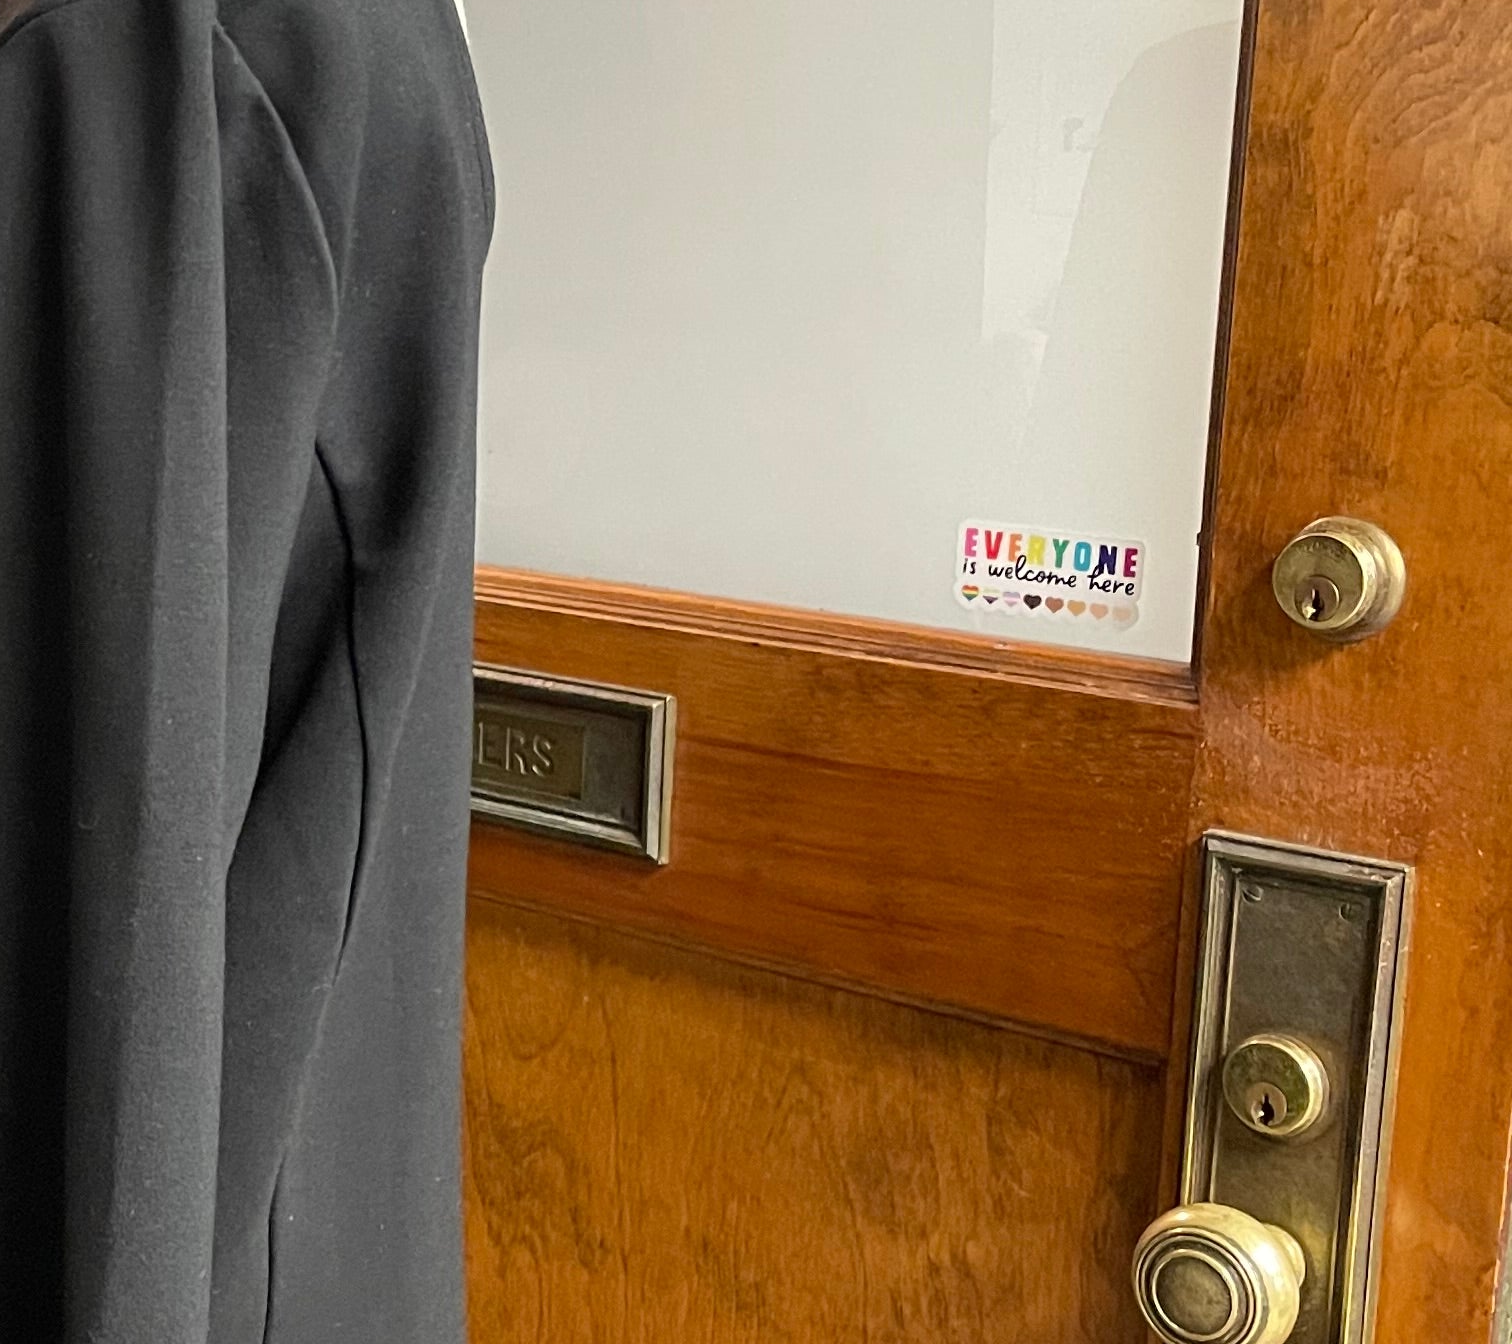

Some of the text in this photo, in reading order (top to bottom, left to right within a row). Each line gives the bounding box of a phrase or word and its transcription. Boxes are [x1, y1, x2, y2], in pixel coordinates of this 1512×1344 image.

[962, 554, 1135, 596] is welcome here
[964, 527, 1138, 578] EVERYONE
